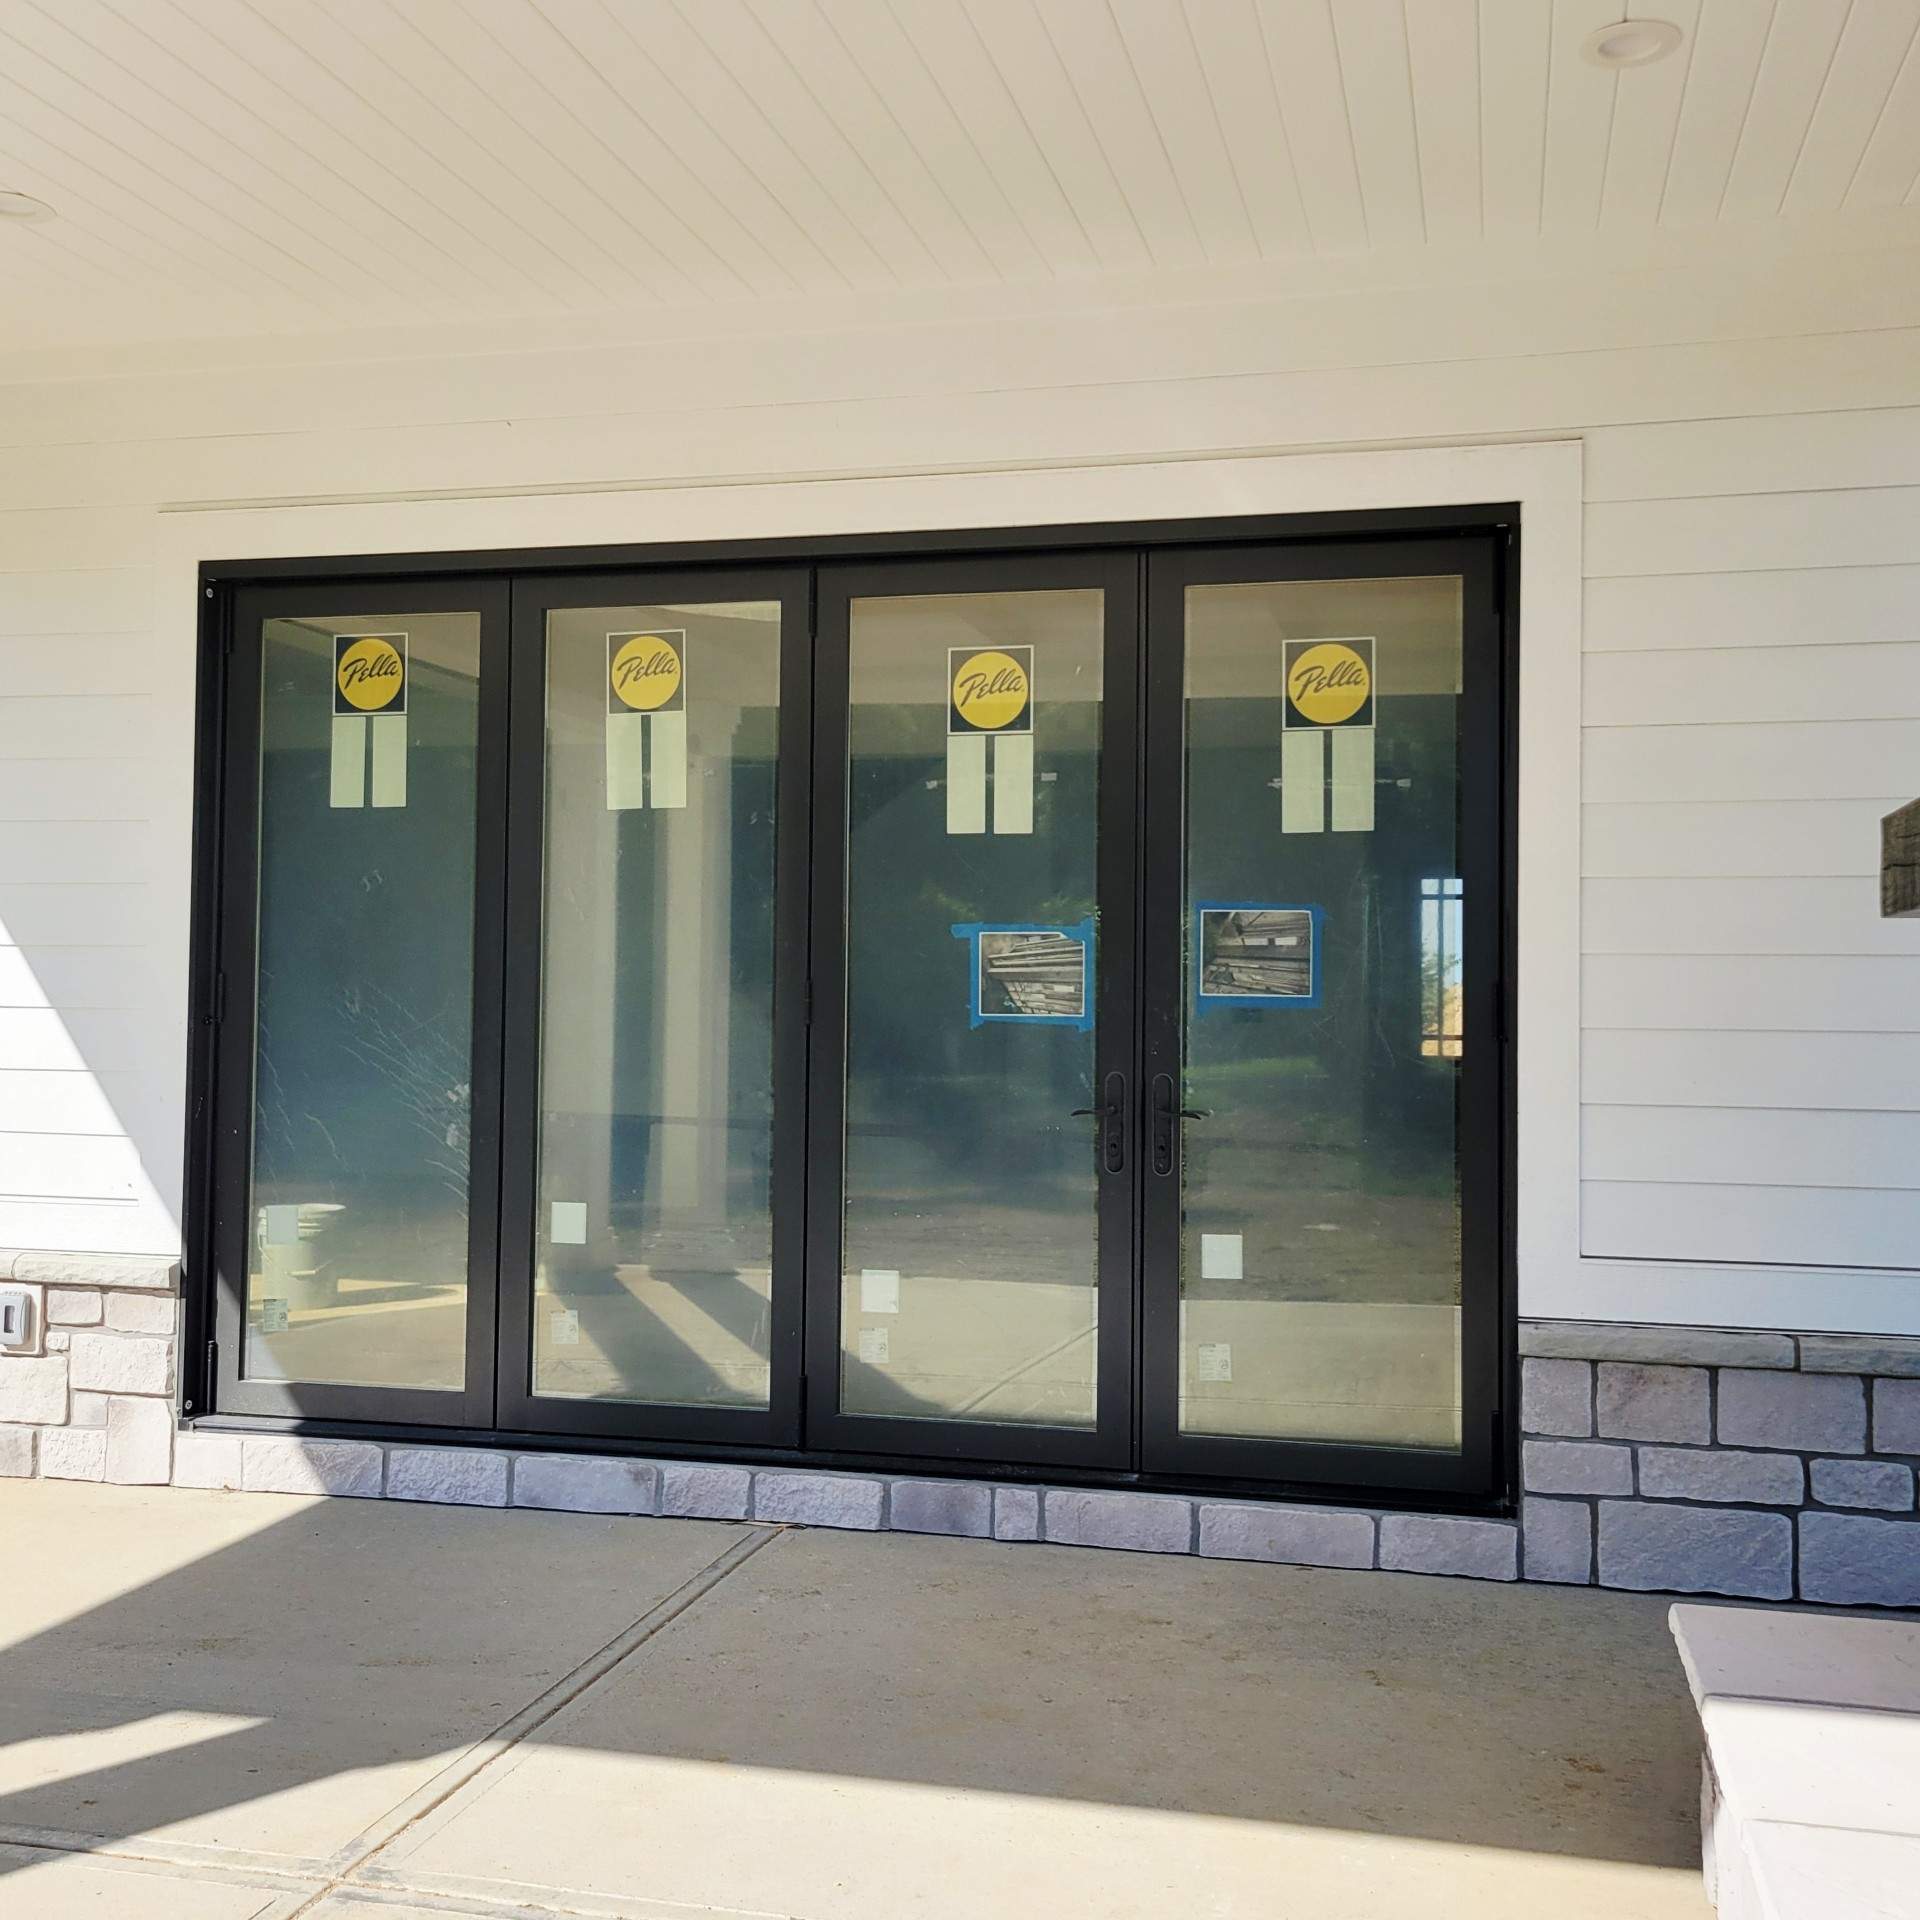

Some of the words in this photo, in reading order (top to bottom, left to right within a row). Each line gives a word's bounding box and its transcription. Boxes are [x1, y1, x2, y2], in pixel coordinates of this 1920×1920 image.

[343, 653, 398, 689] Pella
[617, 651, 675, 690] Pella
[959, 668, 1022, 707] Pella
[1295, 660, 1363, 701] Pella
